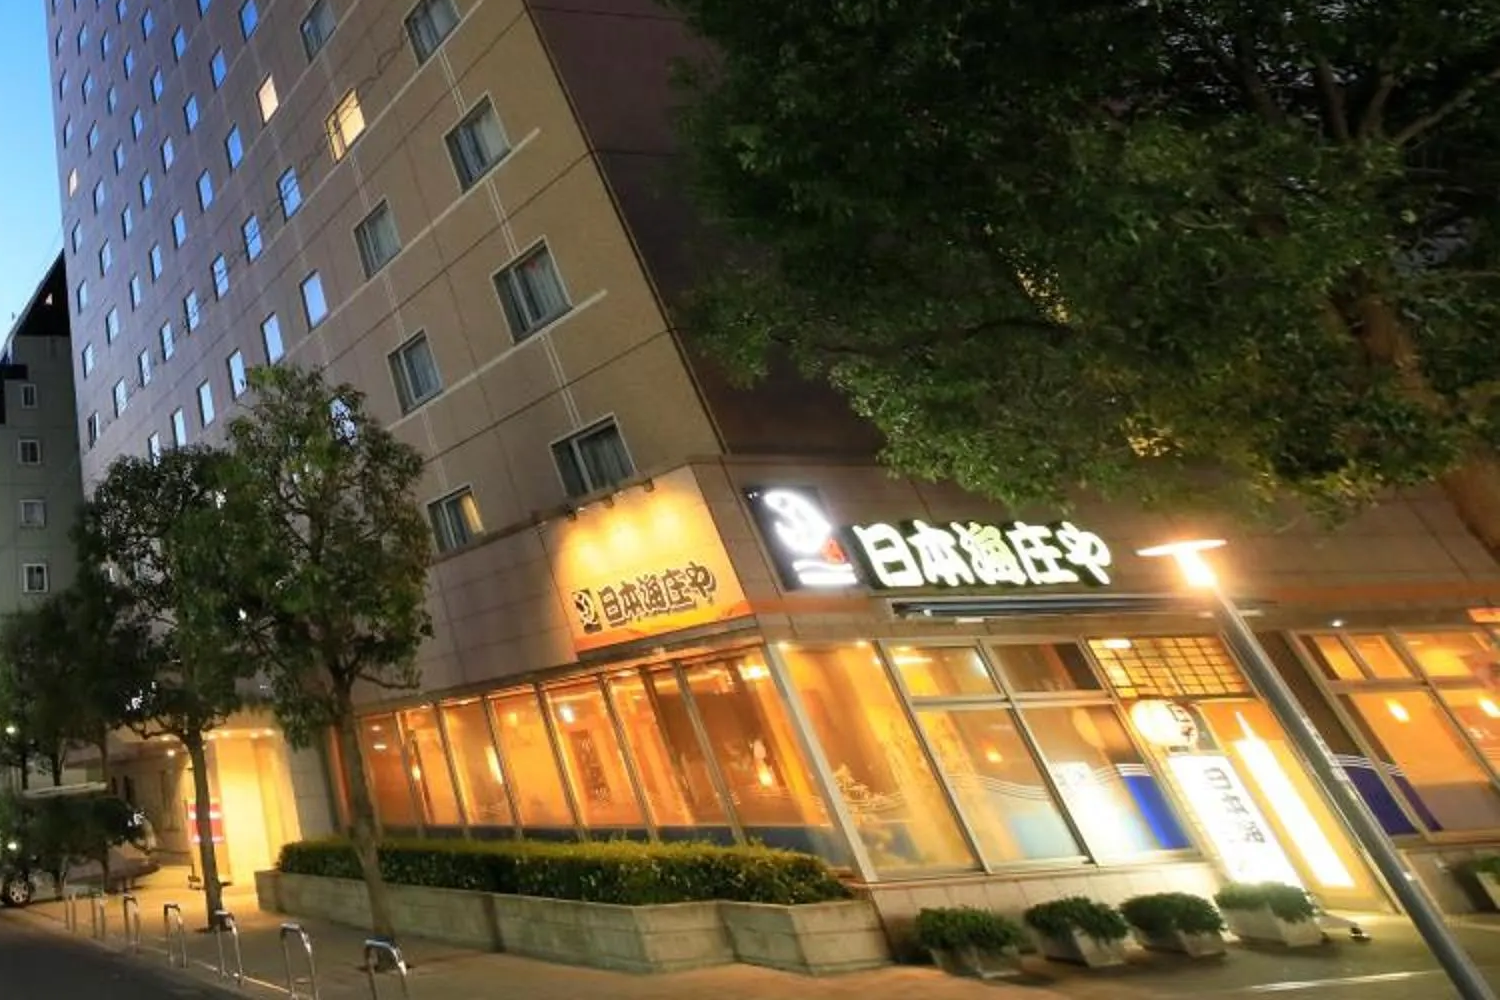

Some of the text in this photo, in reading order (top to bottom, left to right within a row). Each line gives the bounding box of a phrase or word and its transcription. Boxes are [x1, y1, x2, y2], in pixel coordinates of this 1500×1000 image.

[853, 519, 1112, 587] 日本海庄や
[600, 561, 717, 626] 日本海庄や
